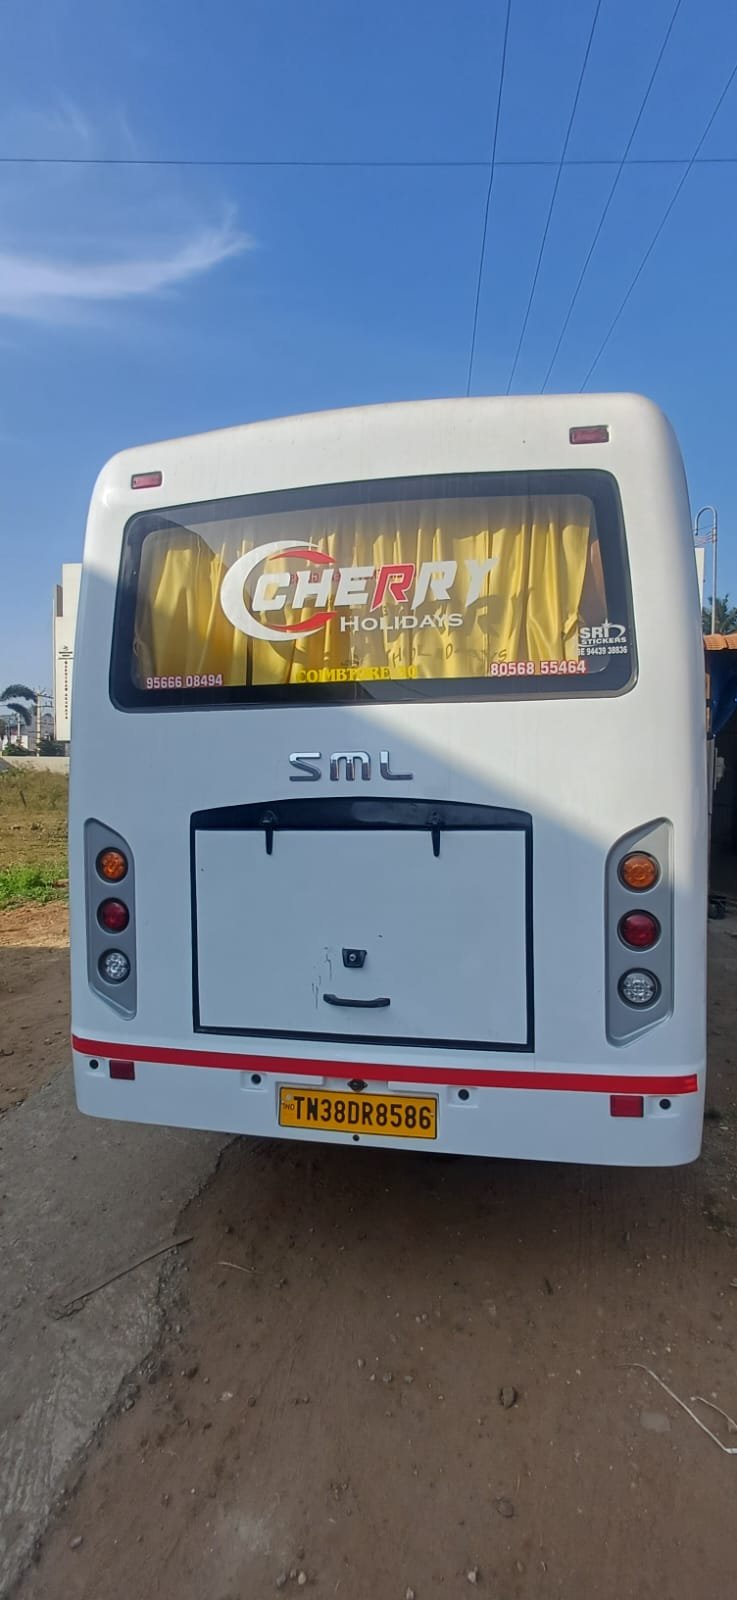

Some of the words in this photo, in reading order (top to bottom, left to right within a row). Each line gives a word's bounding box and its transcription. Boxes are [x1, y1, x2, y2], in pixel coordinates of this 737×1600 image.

[252, 558, 498, 611] CHERRY
[340, 613, 464, 632] HOLIDAYS
[579, 625, 609, 639] SRI
[581, 637, 627, 645] STICKERS
[586, 647, 607, 655] 94439
[490, 661, 535, 676] 80568
[540, 659, 587, 675] 55464
[146, 675, 183, 689] 95666
[185, 674, 224, 688] 08494
[288, 750, 414, 782] SML
[293, 1096, 432, 1129] TN38DR8586
